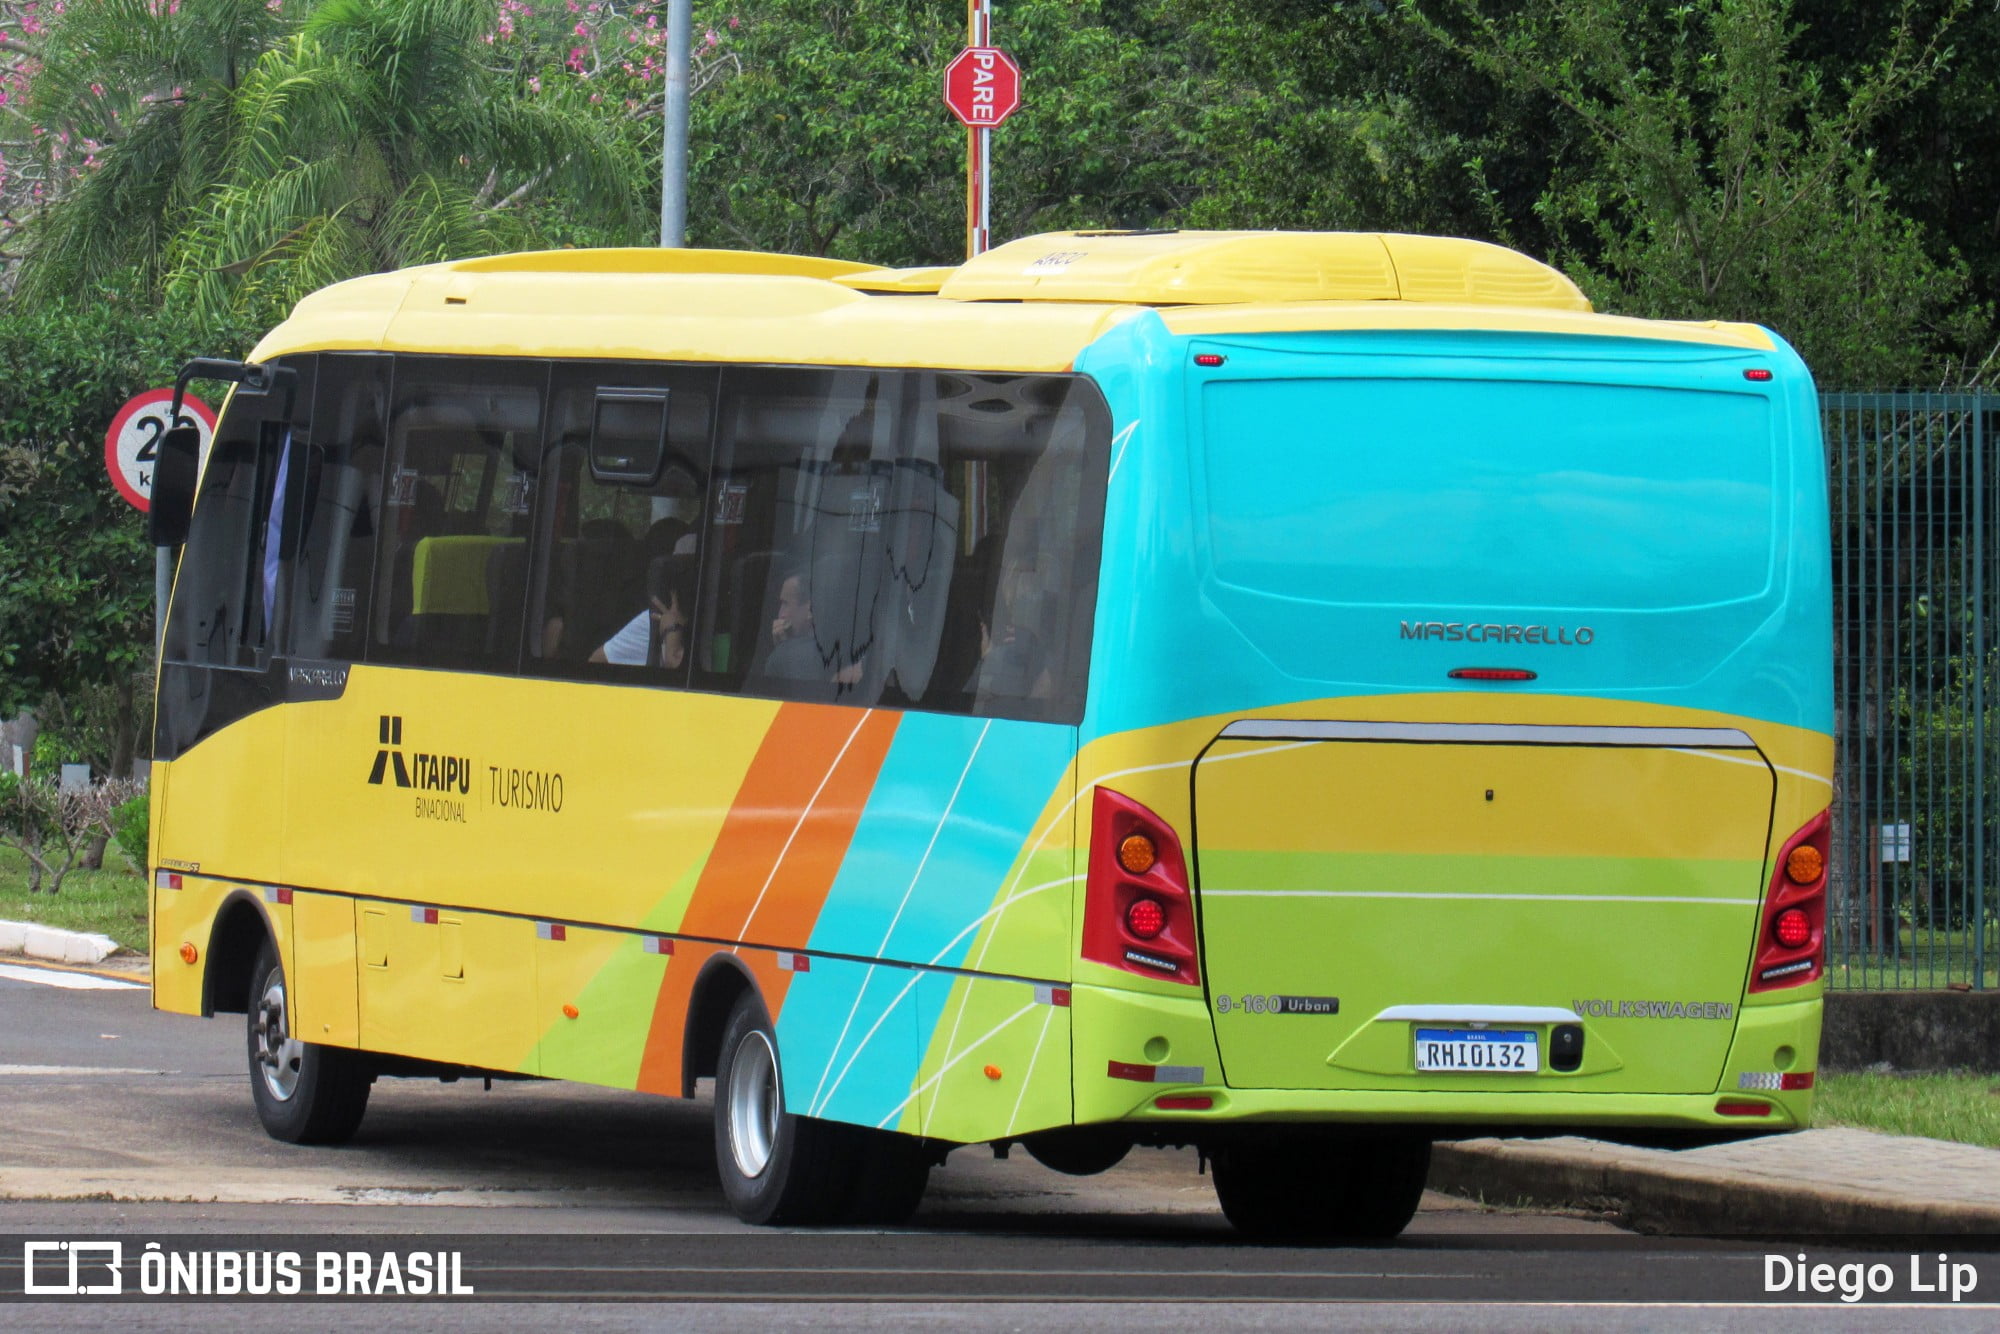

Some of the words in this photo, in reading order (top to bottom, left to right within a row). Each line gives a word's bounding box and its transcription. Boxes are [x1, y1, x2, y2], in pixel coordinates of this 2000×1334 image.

[973, 54, 995, 119] PARE
[1400, 620, 1595, 645] MASCARELLO
[412, 753, 470, 795] ITAIPU
[489, 766, 564, 813] TURISMO
[415, 797, 467, 823] BINACIONAL
[1217, 995, 1282, 1014] 9-160
[1288, 999, 1331, 1012] Urban
[1573, 1000, 1733, 1020] VOLKSWAGEN
